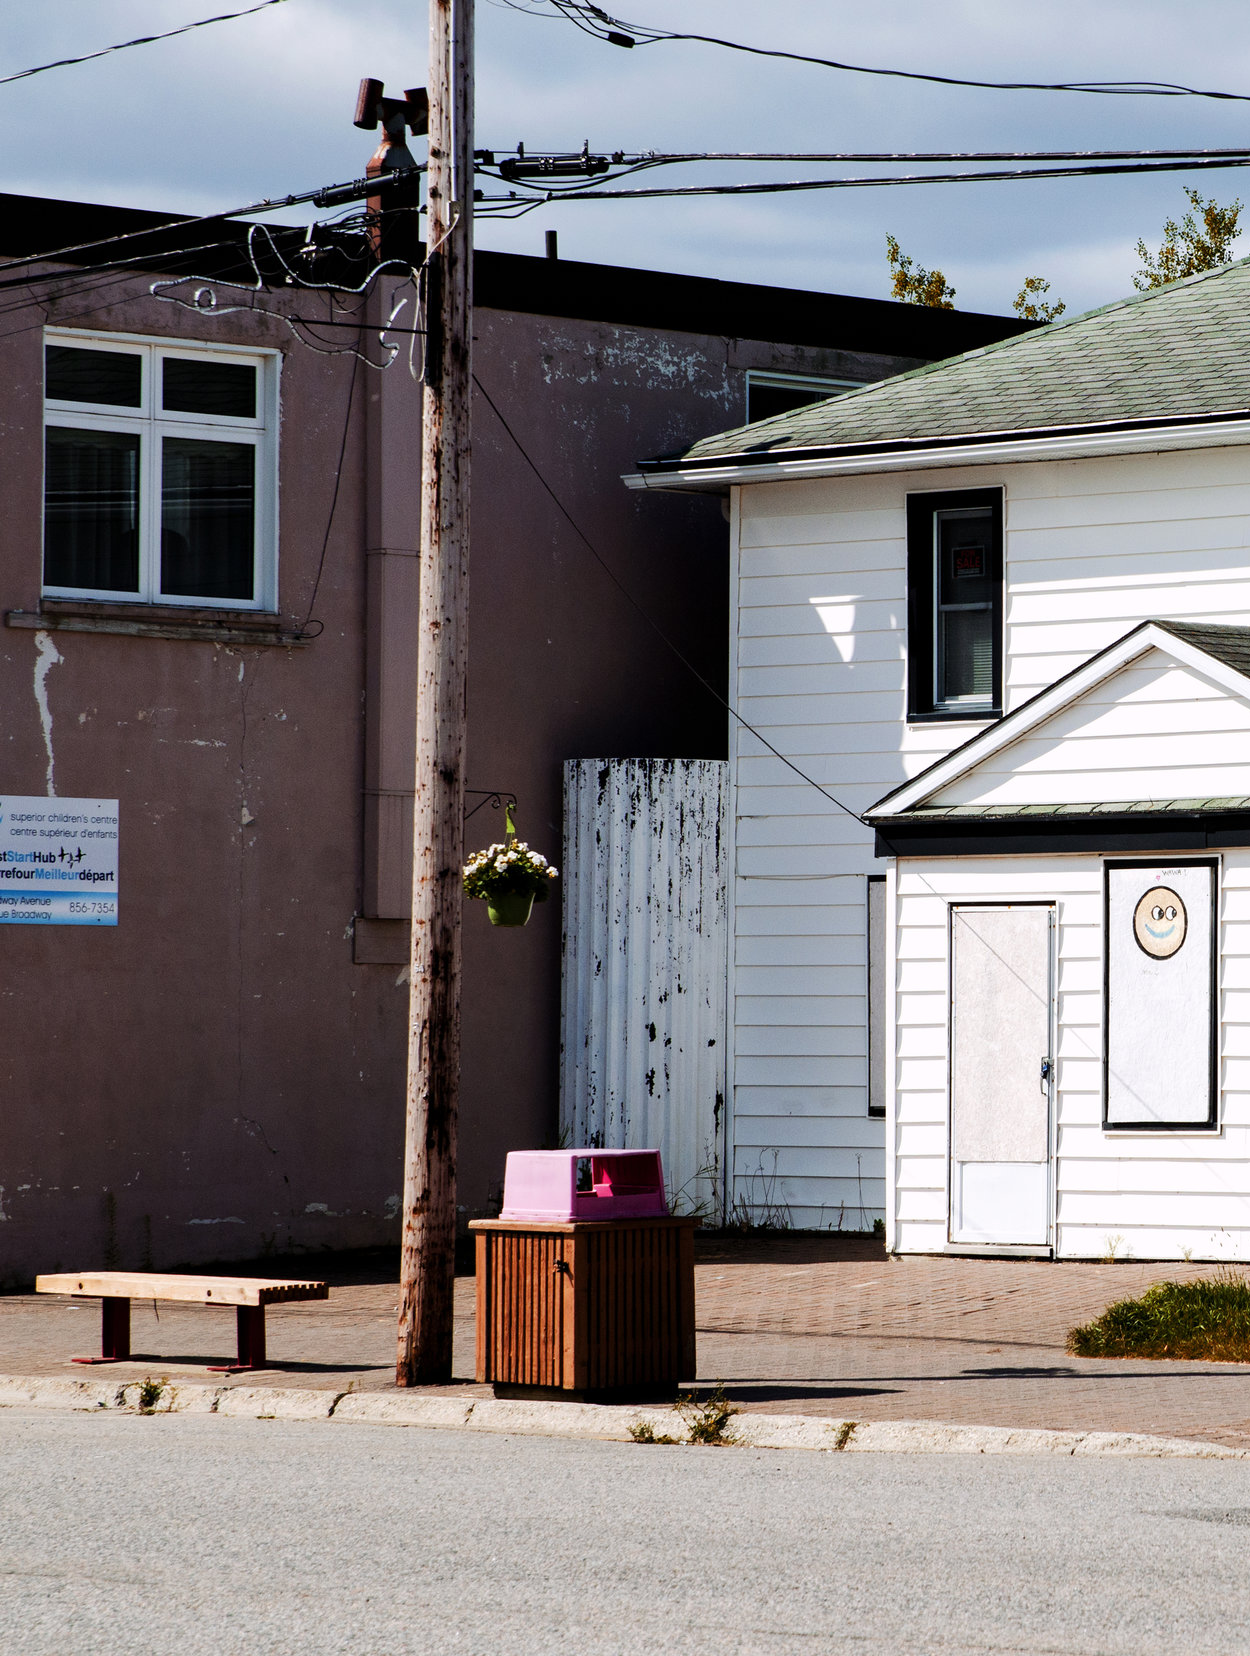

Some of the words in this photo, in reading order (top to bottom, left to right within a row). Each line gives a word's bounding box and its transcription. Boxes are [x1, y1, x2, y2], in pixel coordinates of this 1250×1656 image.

[956, 554, 981, 569] SALE
[10, 813, 46, 823] superior
[48, 813, 88, 824] children's
[91, 816, 117, 824] centre
[10, 828, 37, 836] centre
[40, 829, 78, 838] supérieur
[81, 829, 117, 839] d'enfants
[20, 897, 51, 906] Avenue
[69, 902, 115, 914] 856-7354
[11, 909, 52, 920] Broadway
